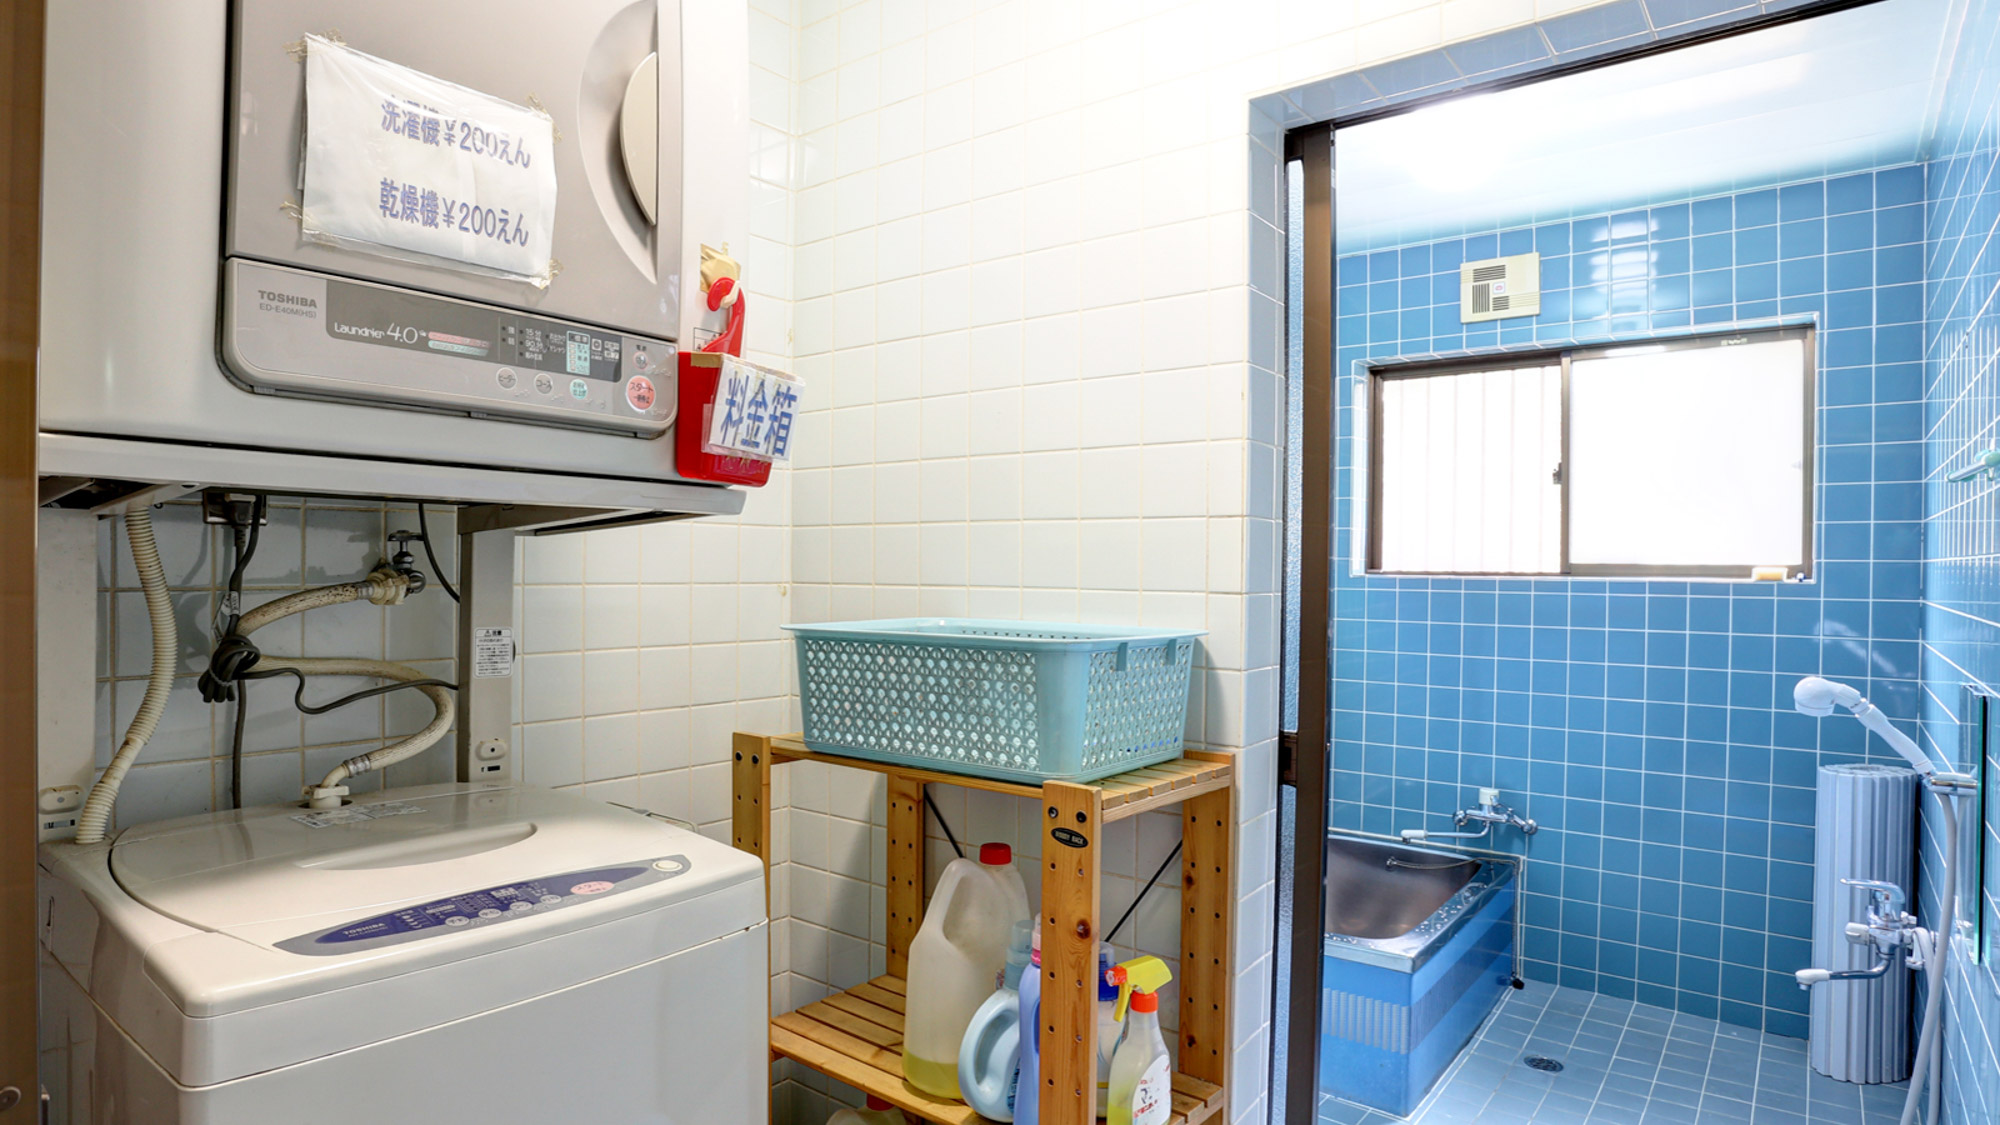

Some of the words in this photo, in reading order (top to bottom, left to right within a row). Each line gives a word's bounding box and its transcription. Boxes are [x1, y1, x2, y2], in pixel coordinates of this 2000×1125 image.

[258, 289, 317, 308] TOSHIBA
[386, 323, 418, 344] 4.0
[630, 381, 655, 393] スタート
[721, 371, 797, 456] 料金箱
[343, 923, 386, 935] TOSHIBA
